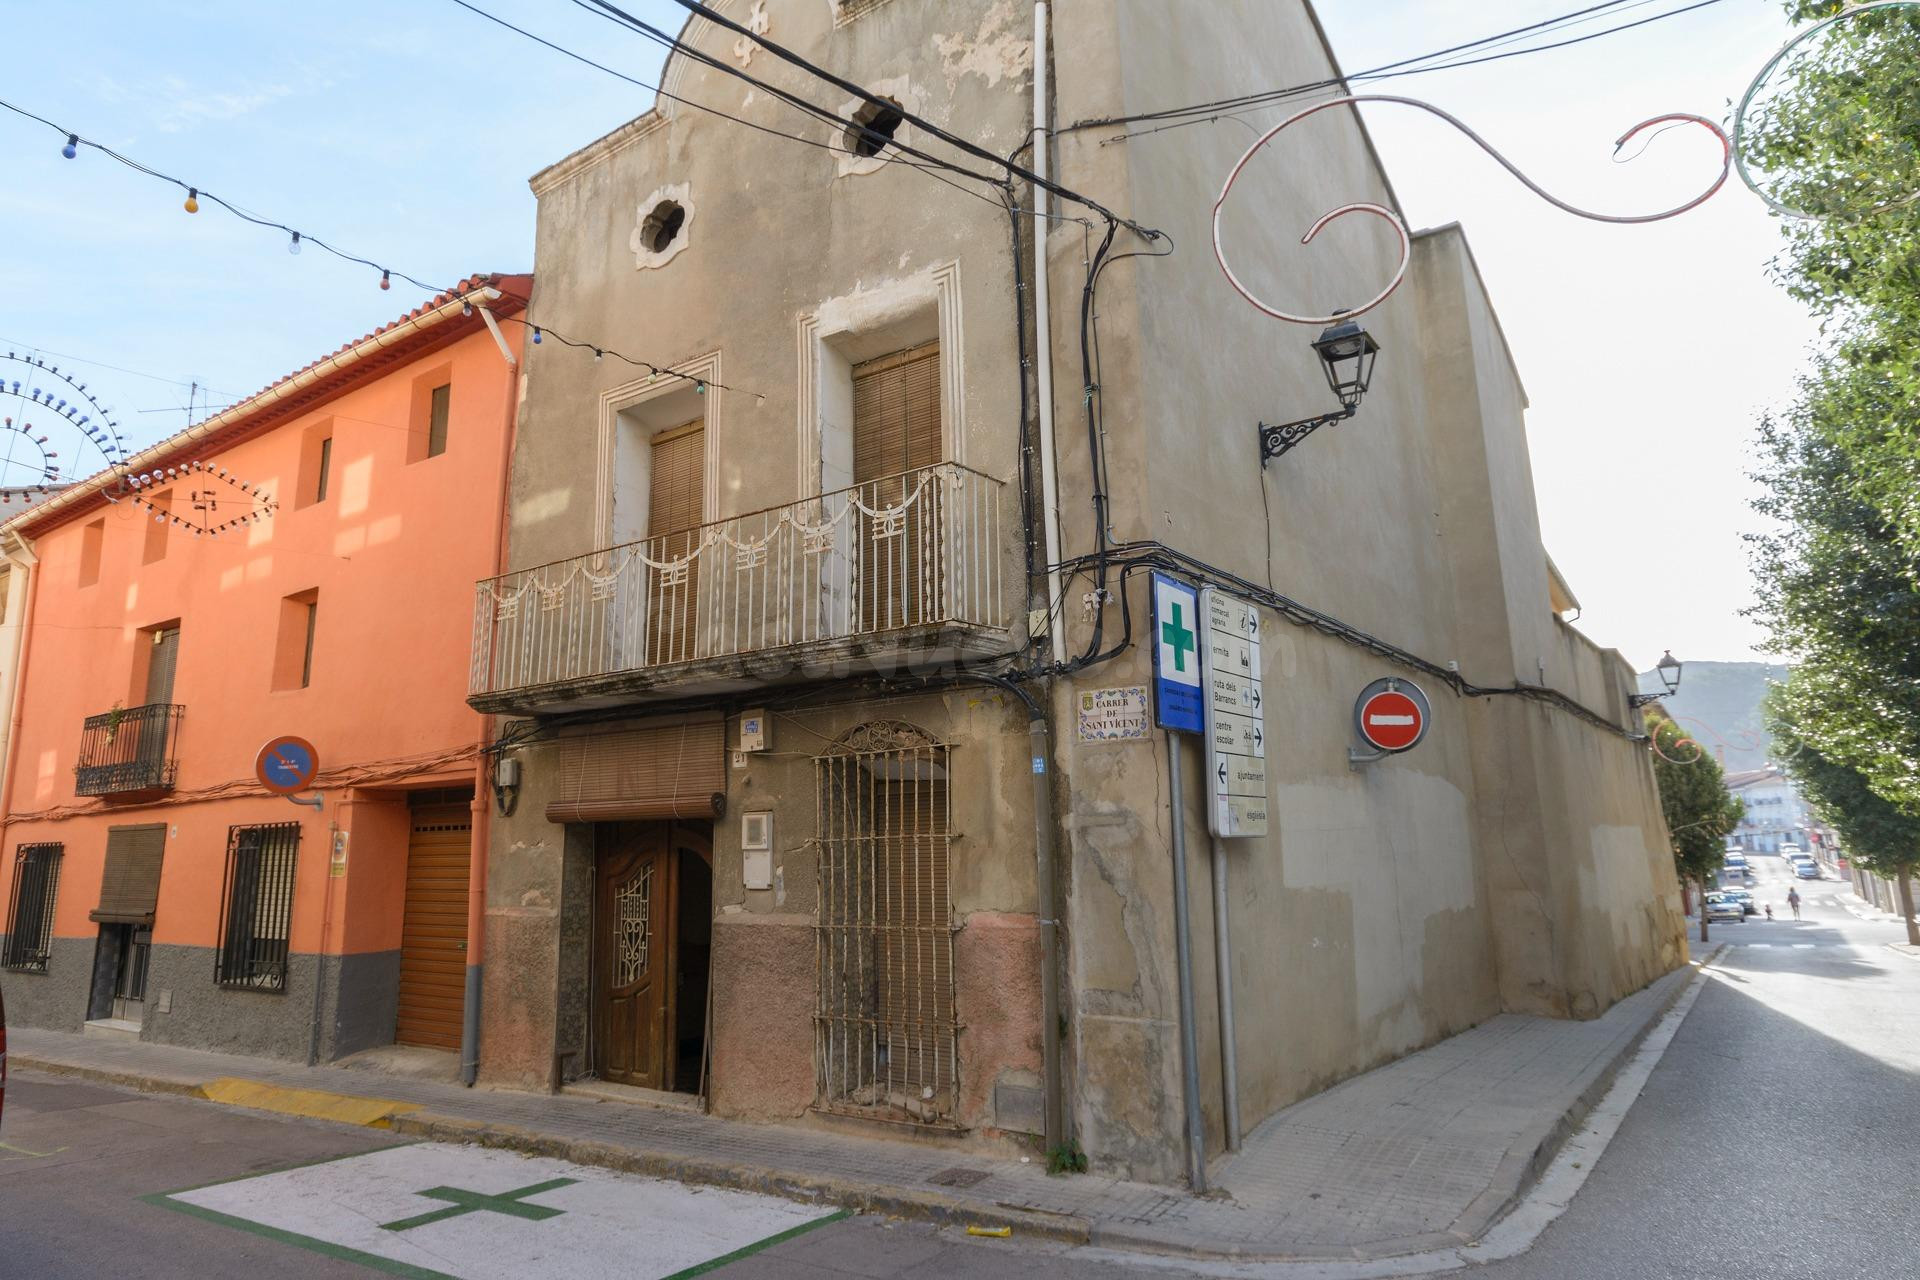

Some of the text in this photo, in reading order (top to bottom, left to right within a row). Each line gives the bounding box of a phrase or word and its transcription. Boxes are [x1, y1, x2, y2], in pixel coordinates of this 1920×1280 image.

[1212, 645, 1230, 658] ermita
[1214, 680, 1237, 692] ruta dels
[1096, 698, 1129, 709] CARRER
[1214, 691, 1237, 706] Barrancs
[1106, 710, 1118, 718] DE
[1086, 720, 1107, 730] SANT
[1215, 721, 1232, 732] centre
[1216, 735, 1235, 746] escolar
[734, 753, 745, 763] 21
